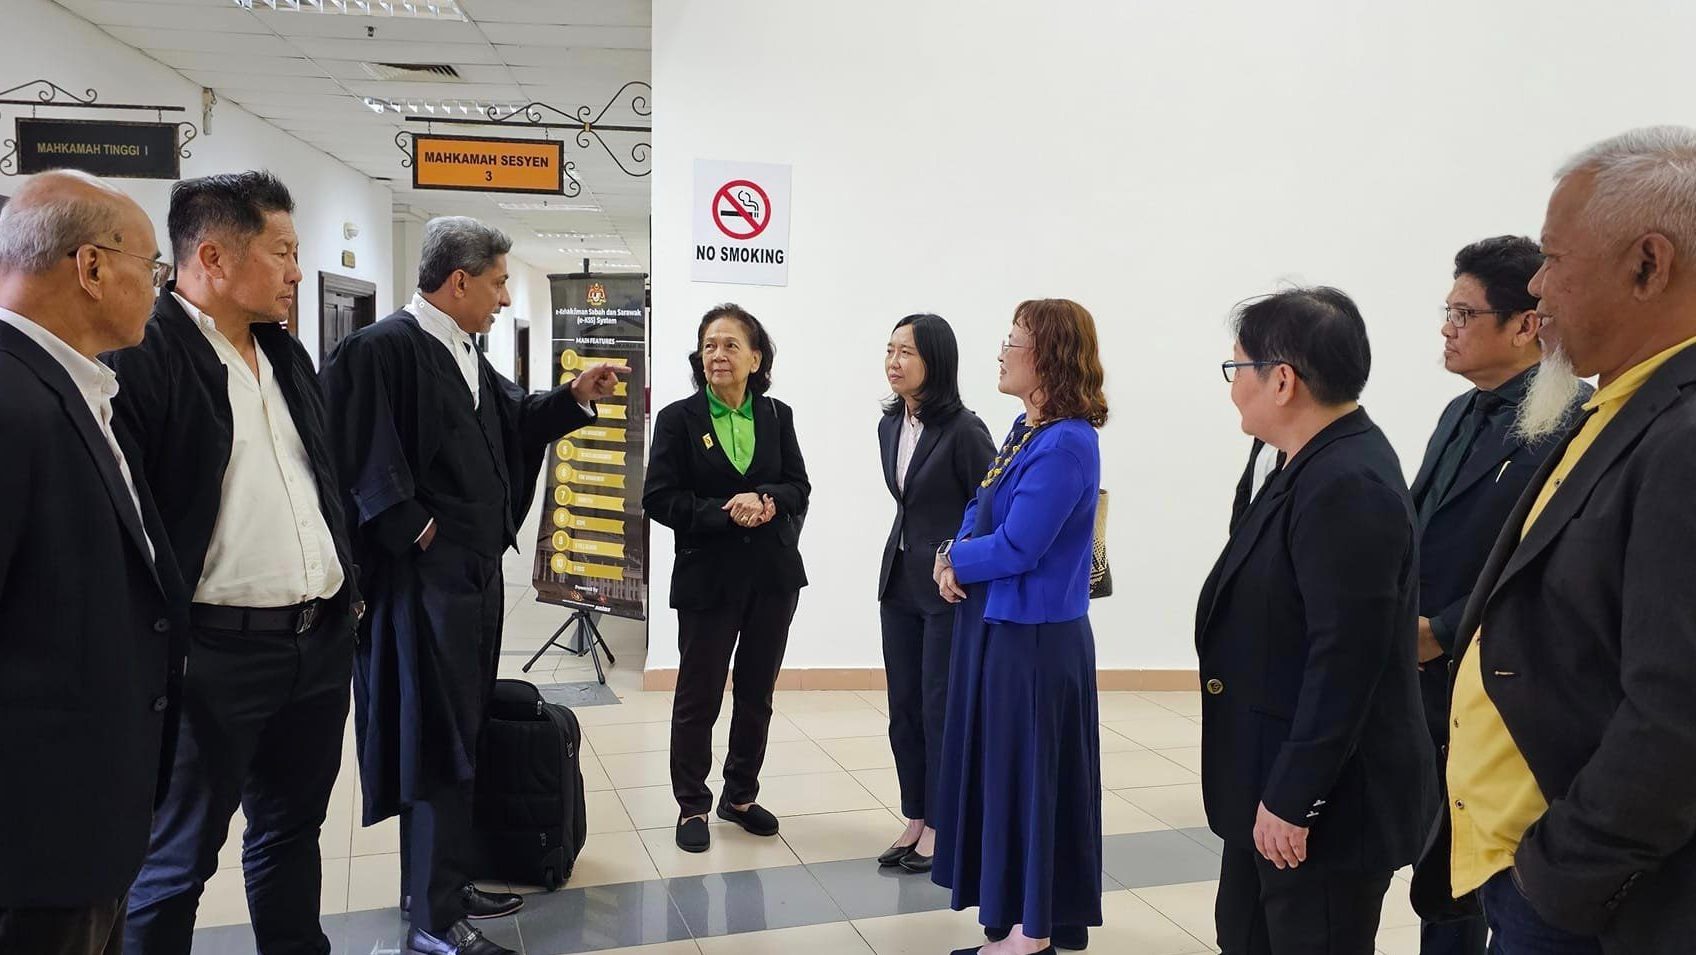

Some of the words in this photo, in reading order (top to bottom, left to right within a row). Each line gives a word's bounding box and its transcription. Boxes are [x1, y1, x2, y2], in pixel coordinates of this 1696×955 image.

[37, 142, 101, 155] MAHKAMAH
[103, 144, 140, 156] TINGGI
[424, 152, 497, 166] MAHKAMAH
[501, 155, 549, 168] SESYEN
[485, 170, 493, 182] 3
[696, 245, 716, 261] NO
[720, 246, 784, 264] SMOKING
[588, 308, 606, 316] Sabah
[606, 308, 617, 316] dan
[617, 309, 642, 317] Sarawak
[596, 317, 617, 326] System
[590, 337, 616, 345] FEATURES
